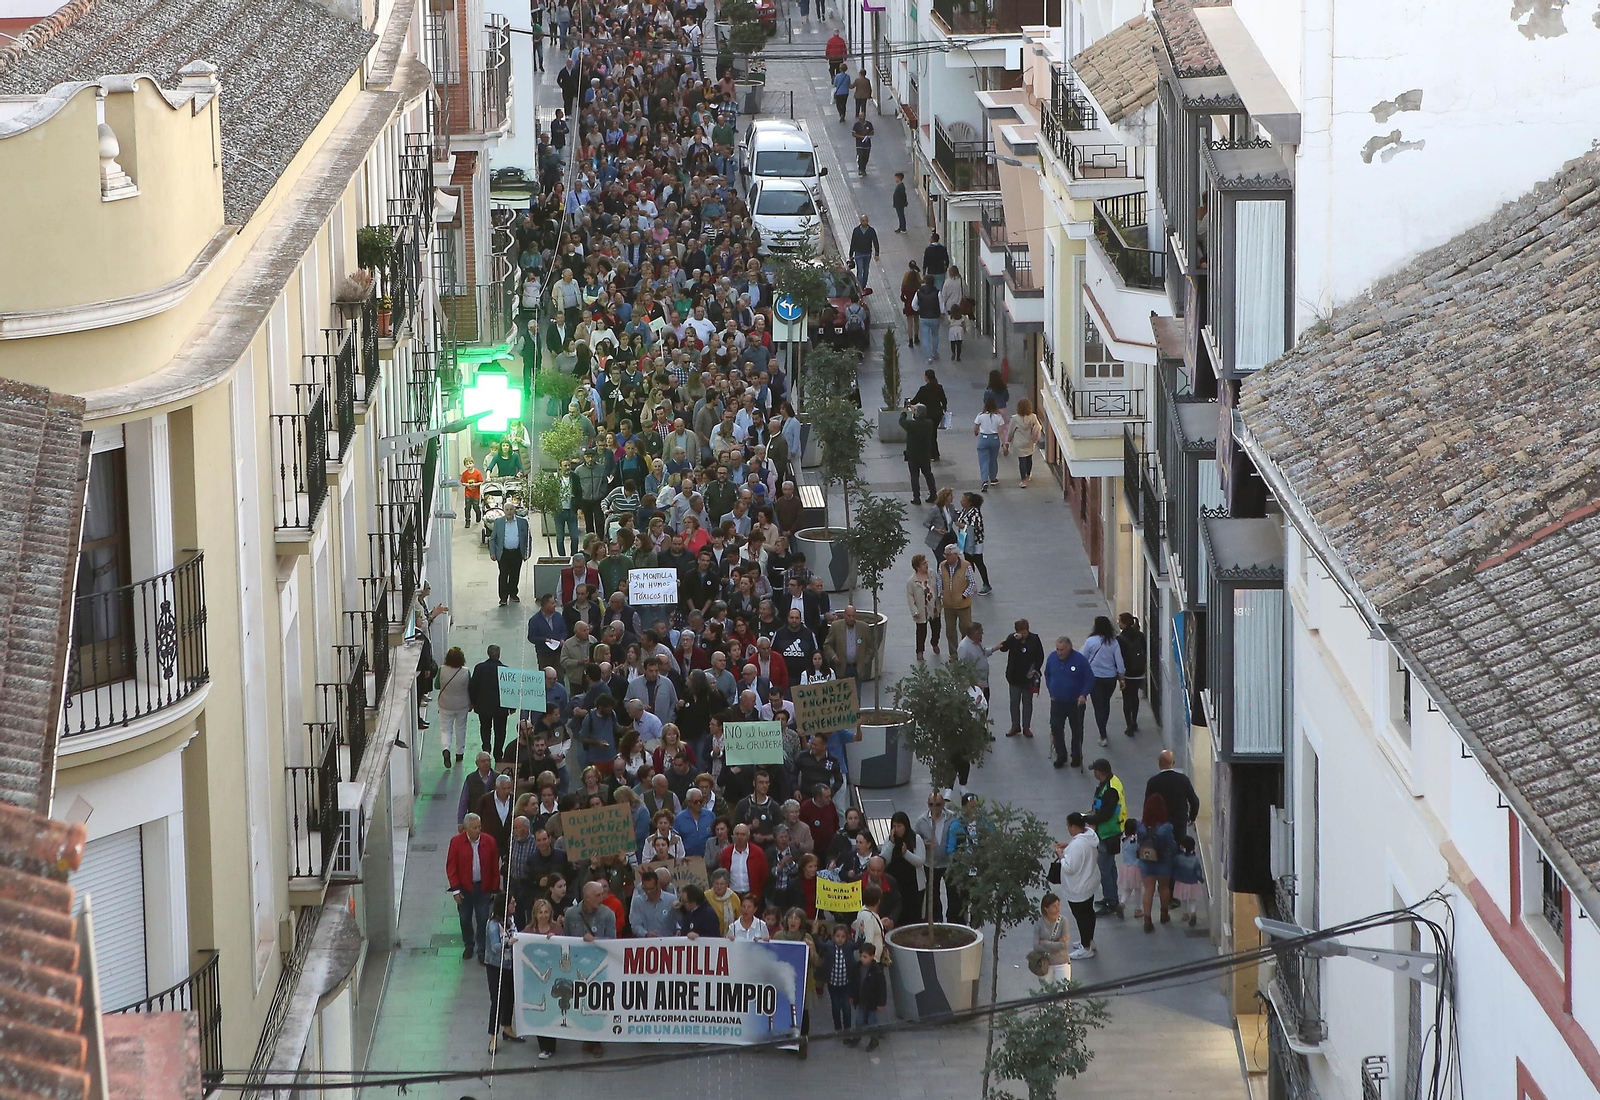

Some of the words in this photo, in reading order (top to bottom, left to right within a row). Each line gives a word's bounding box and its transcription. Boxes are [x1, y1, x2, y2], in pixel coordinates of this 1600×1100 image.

[642, 572, 673, 580] MONTILLA
[648, 581, 671, 589] HUMOS
[500, 672, 517, 682] AIRE
[797, 687, 818, 698] QUE
[822, 685, 834, 695] NO
[836, 682, 850, 692] TE
[803, 690, 853, 709] ENGAÑEN
[725, 726, 742, 739] NO
[746, 726, 756, 738] al
[758, 727, 781, 738] humo
[592, 812, 605, 823] NO
[608, 809, 622, 819] TE
[567, 836, 586, 849] NOS
[624, 946, 729, 976] MONTILLA
[574, 981, 615, 1011] POR
[621, 981, 648, 1010] UN
[654, 981, 699, 1010] AIRE
[705, 982, 776, 1015] LIMPIO
[628, 1014, 689, 1023] PLATAFORMA
[689, 1015, 742, 1025] CIUDADANA
[627, 1025, 652, 1034] POR
[653, 1025, 671, 1035] UN
[672, 1025, 700, 1035] AIRE
[701, 1026, 742, 1037] LIMPIO
